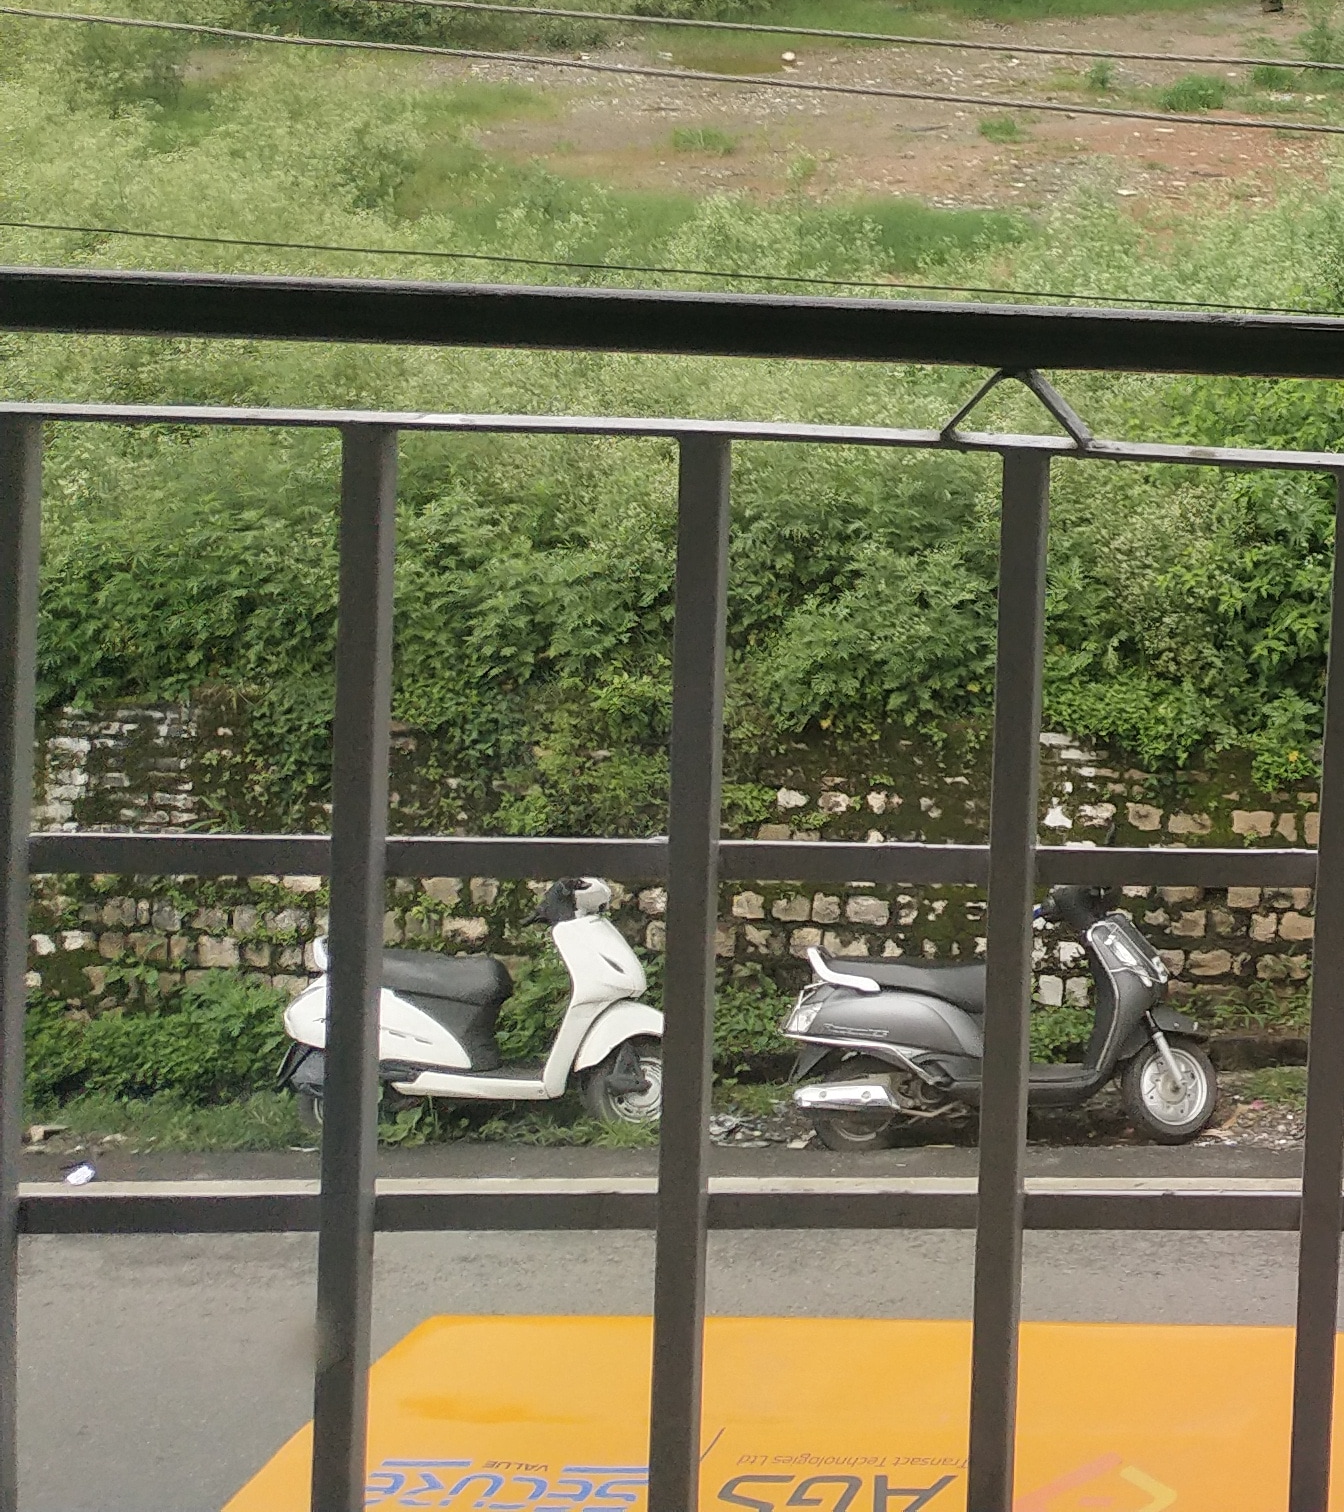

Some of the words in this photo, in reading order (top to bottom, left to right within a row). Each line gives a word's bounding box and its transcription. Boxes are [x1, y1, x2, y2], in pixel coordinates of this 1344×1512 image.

[483, 1459, 549, 1472] VALUE
[736, 1454, 769, 1466] Ltd
[771, 1452, 888, 1468] Technologies
[892, 1456, 969, 1468] Transact
[365, 1472, 649, 1512] SECURE
[717, 1475, 958, 1512] AGS
